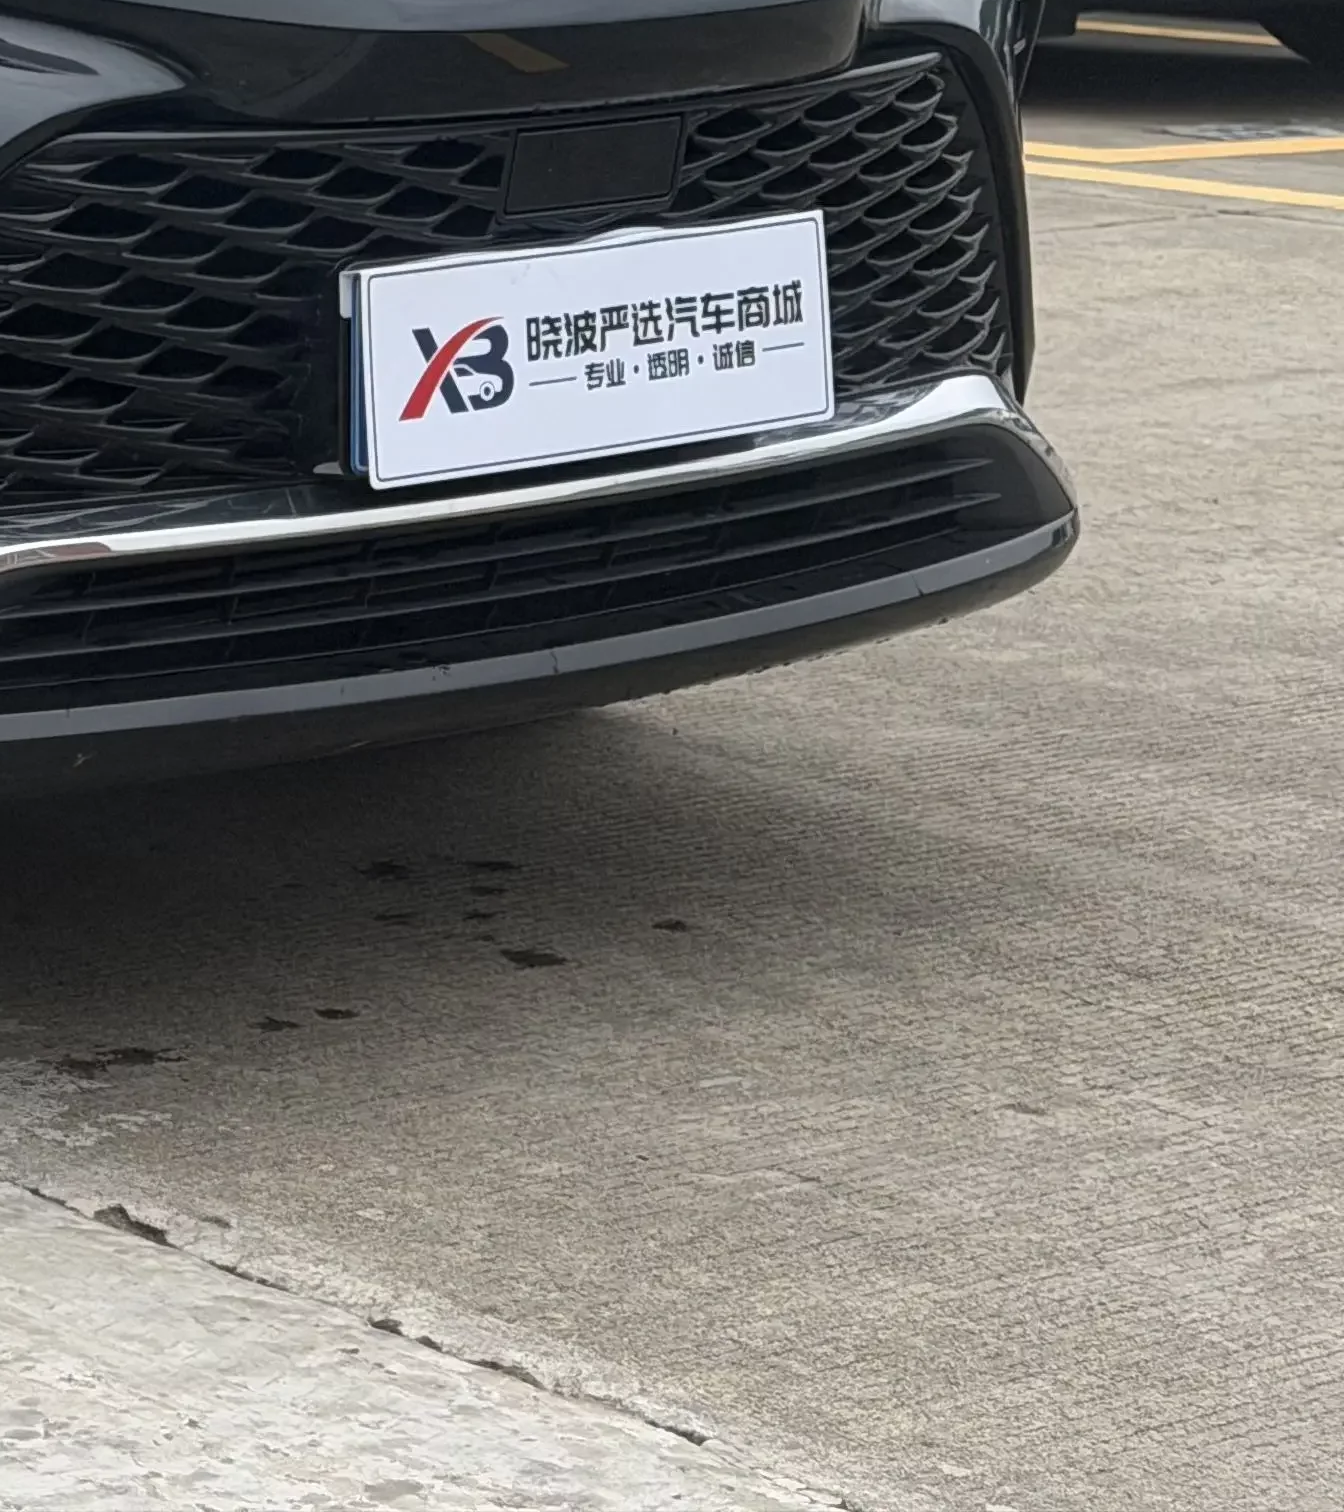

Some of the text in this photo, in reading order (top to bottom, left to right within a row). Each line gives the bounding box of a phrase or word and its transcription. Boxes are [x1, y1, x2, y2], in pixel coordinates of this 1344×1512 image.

[525, 280, 804, 362] 晓波严选汽车商城
